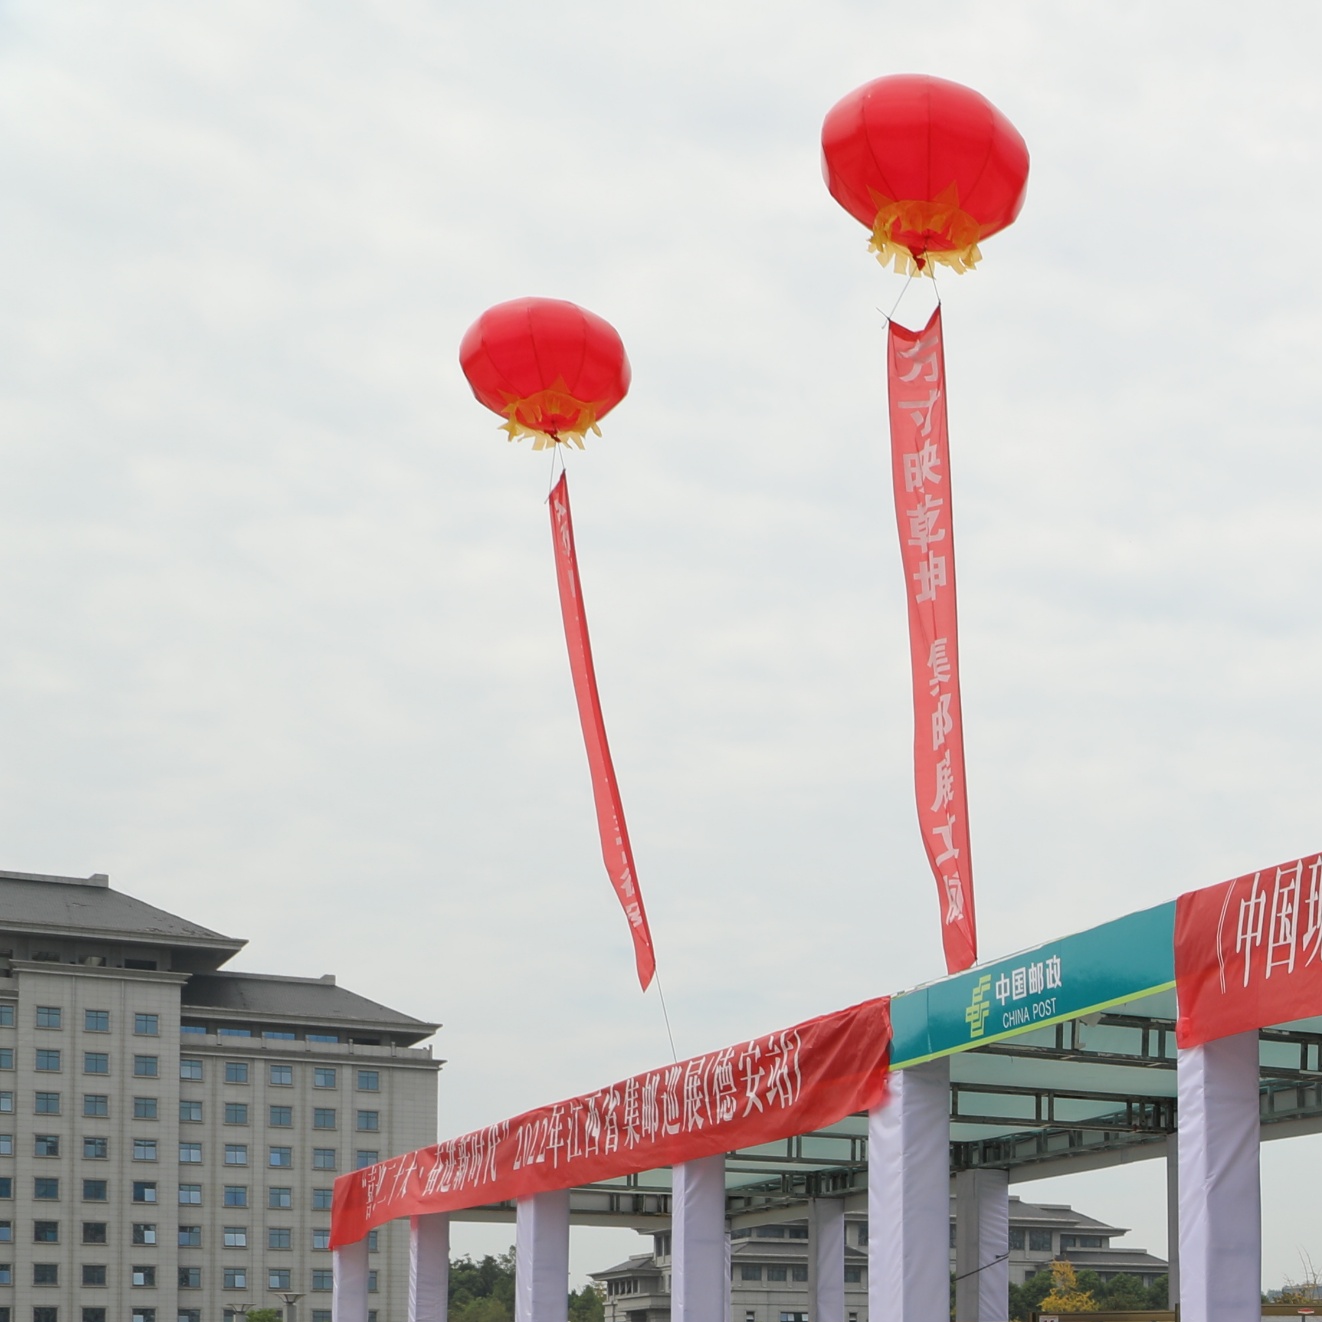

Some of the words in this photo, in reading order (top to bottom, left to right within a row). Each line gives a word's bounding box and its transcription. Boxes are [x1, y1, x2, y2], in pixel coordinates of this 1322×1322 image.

[995, 955, 1062, 1006] 中国邮政
[1002, 1006, 1030, 1029] CHINA
[1033, 998, 1056, 1020] POST
